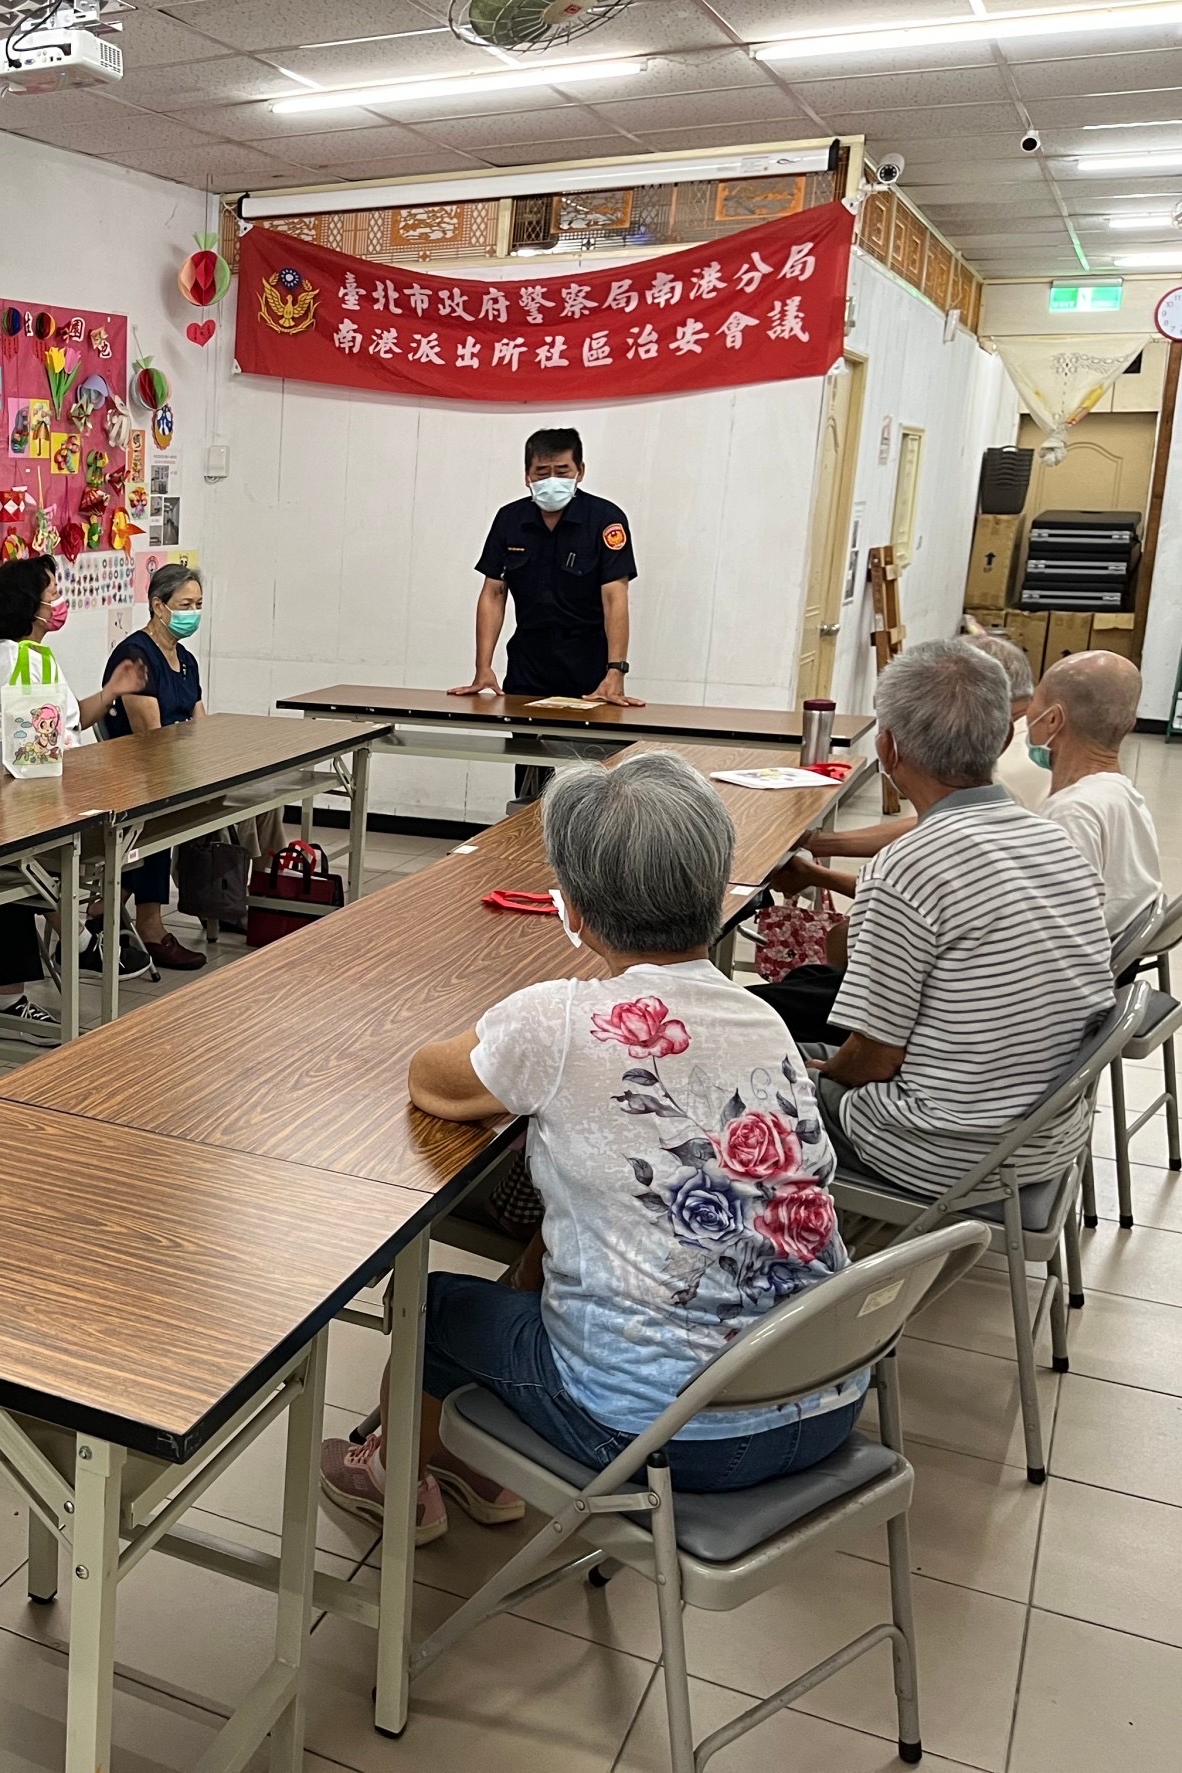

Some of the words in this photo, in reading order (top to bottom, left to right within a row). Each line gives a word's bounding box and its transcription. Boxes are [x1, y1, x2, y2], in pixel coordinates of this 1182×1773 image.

[338, 241, 816, 324] 臺北市政府警察局南港分局
[333, 296, 810, 372] 南港派出所社區治安會議
